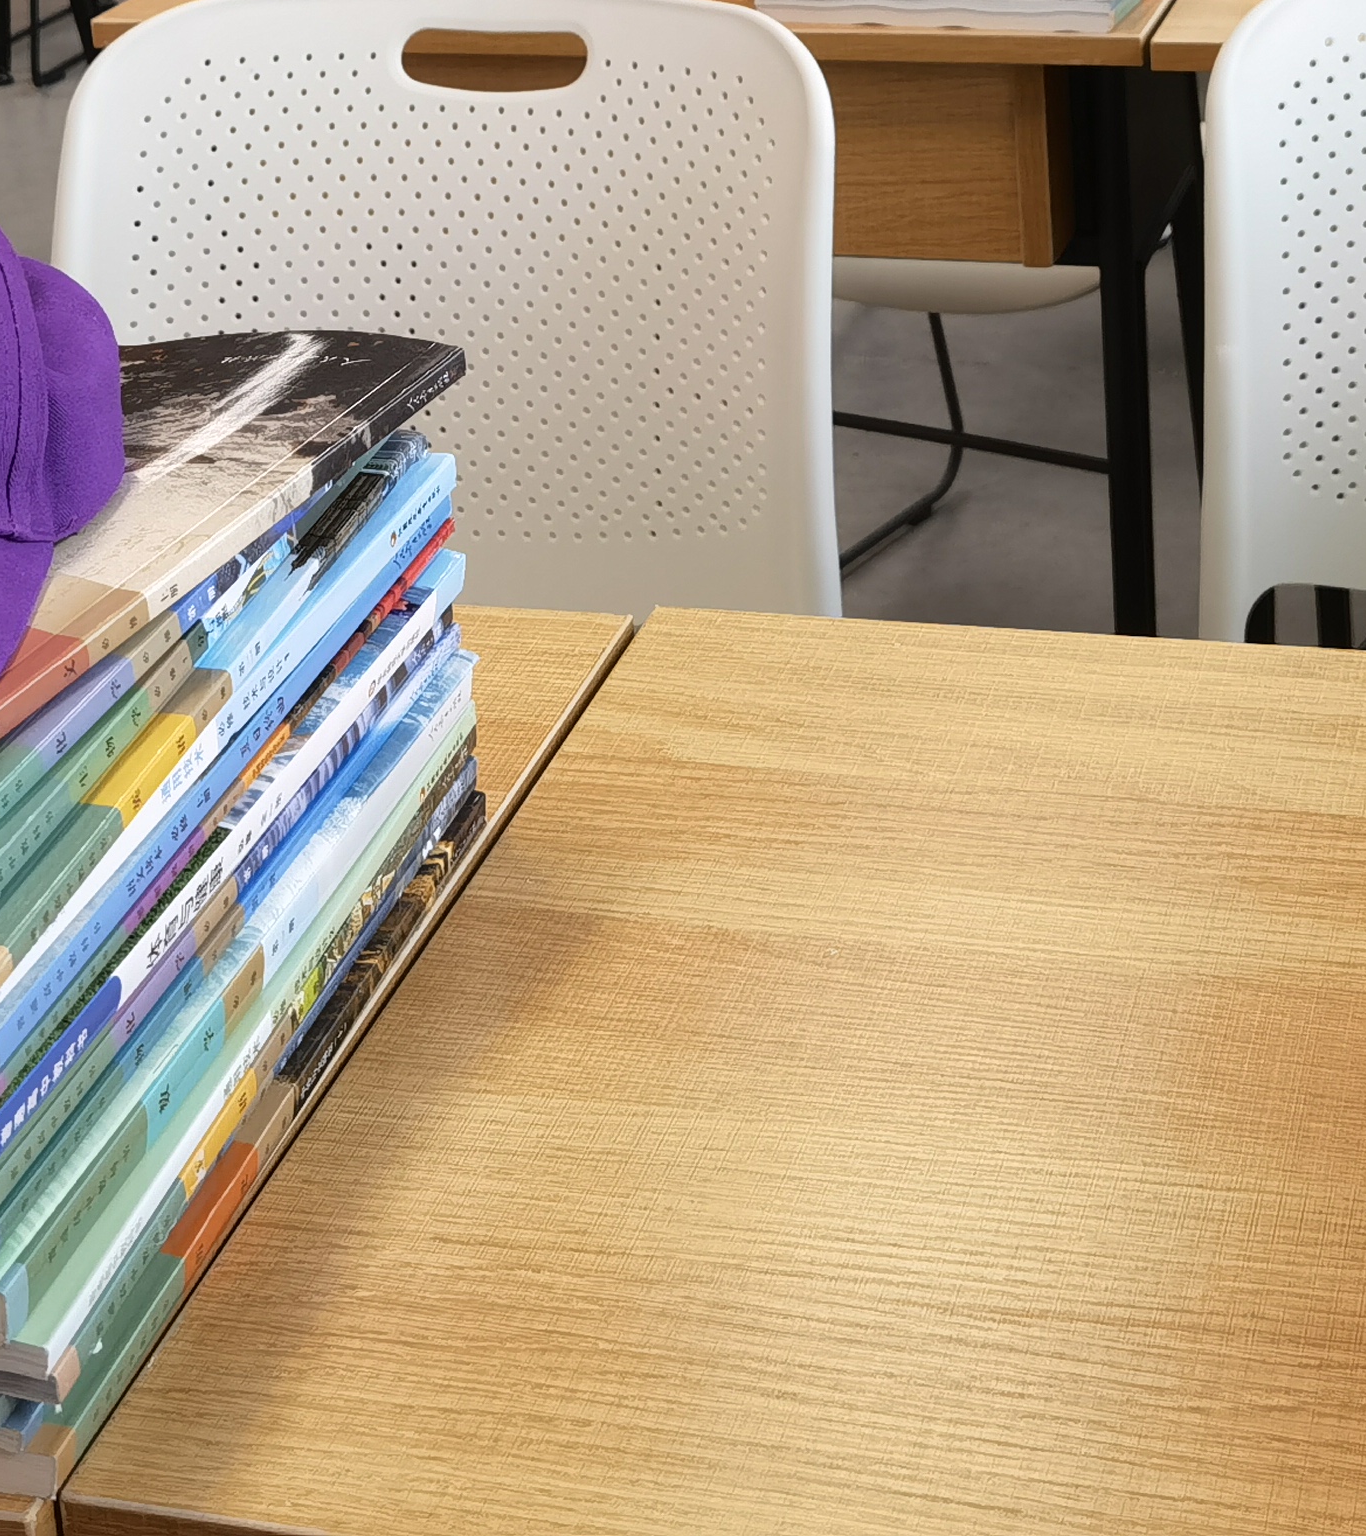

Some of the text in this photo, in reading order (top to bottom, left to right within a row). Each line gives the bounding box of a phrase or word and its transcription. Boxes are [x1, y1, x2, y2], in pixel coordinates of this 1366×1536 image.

[100, 614, 138, 651] 必修
[160, 582, 178, 605] 上册
[54, 675, 122, 755] 化学
[142, 628, 171, 664] 必修
[76, 705, 143, 790] 生物学
[130, 733, 187, 810] 英语
[158, 745, 205, 803] 通用技术
[216, 711, 234, 737] 必修
[170, 814, 188, 842] 必修
[195, 787, 212, 811] 上册
[141, 854, 227, 972] 体育与健康
[123, 951, 185, 1034] 化学
[155, 1025, 216, 1113] 数学
